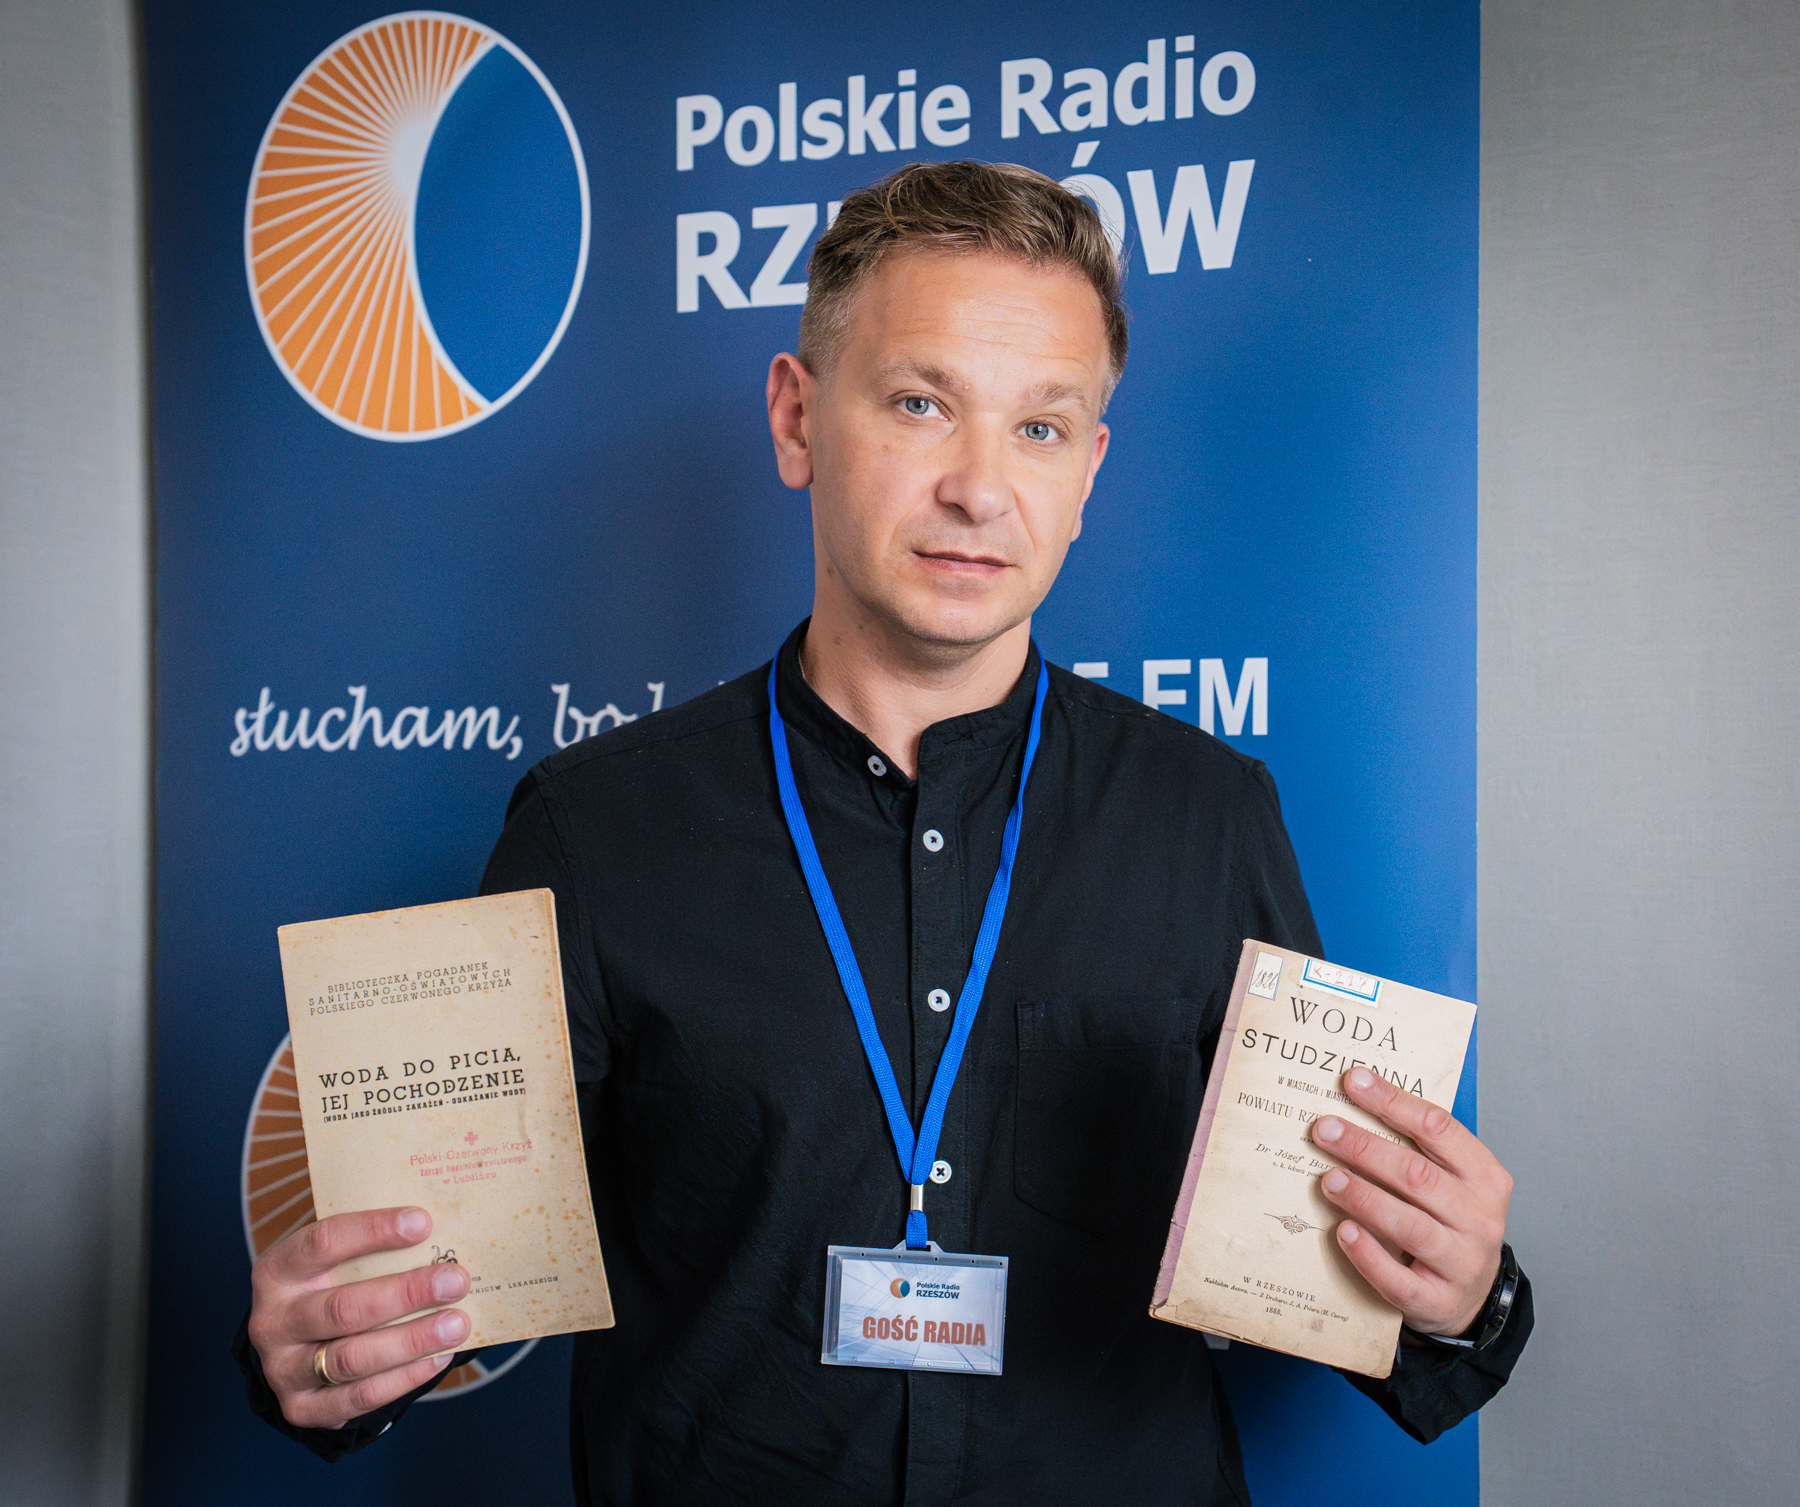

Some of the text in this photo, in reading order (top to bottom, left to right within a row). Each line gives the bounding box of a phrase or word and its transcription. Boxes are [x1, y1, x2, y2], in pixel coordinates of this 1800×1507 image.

[676, 34, 1257, 171] Polskie Radio
[676, 141, 1256, 313] RZÓW
[1143, 657, 1268, 736] FM
[308, 968, 511, 1006] SANITARNO-OŚWIATOWYCH
[327, 961, 489, 993] BIBLIOTECZKA POGADANEK
[310, 998, 374, 1016] POLSKIEGO
[381, 985, 461, 1005] CZERWONEGO
[1290, 996, 1397, 1052] WODA
[318, 1047, 520, 1089] WODA DO PICIA,
[321, 1068, 524, 1113] JEJ POCHODZENIE
[1278, 1075, 1285, 1085] W
[1286, 1078, 1320, 1096] MIASTACH
[1237, 1092, 1294, 1119] POWIATU
[410, 1138, 533, 1166] Polski Czerwony Krzyż
[1255, 1143, 1305, 1164] Dr Józef
[916, 1281, 960, 1291] Polskie Radio
[916, 1289, 960, 1300] RZESZÓW
[1243, 1276, 1316, 1303] W RZESZOWIE
[862, 1314, 987, 1347] GOŚĆ RADIA
